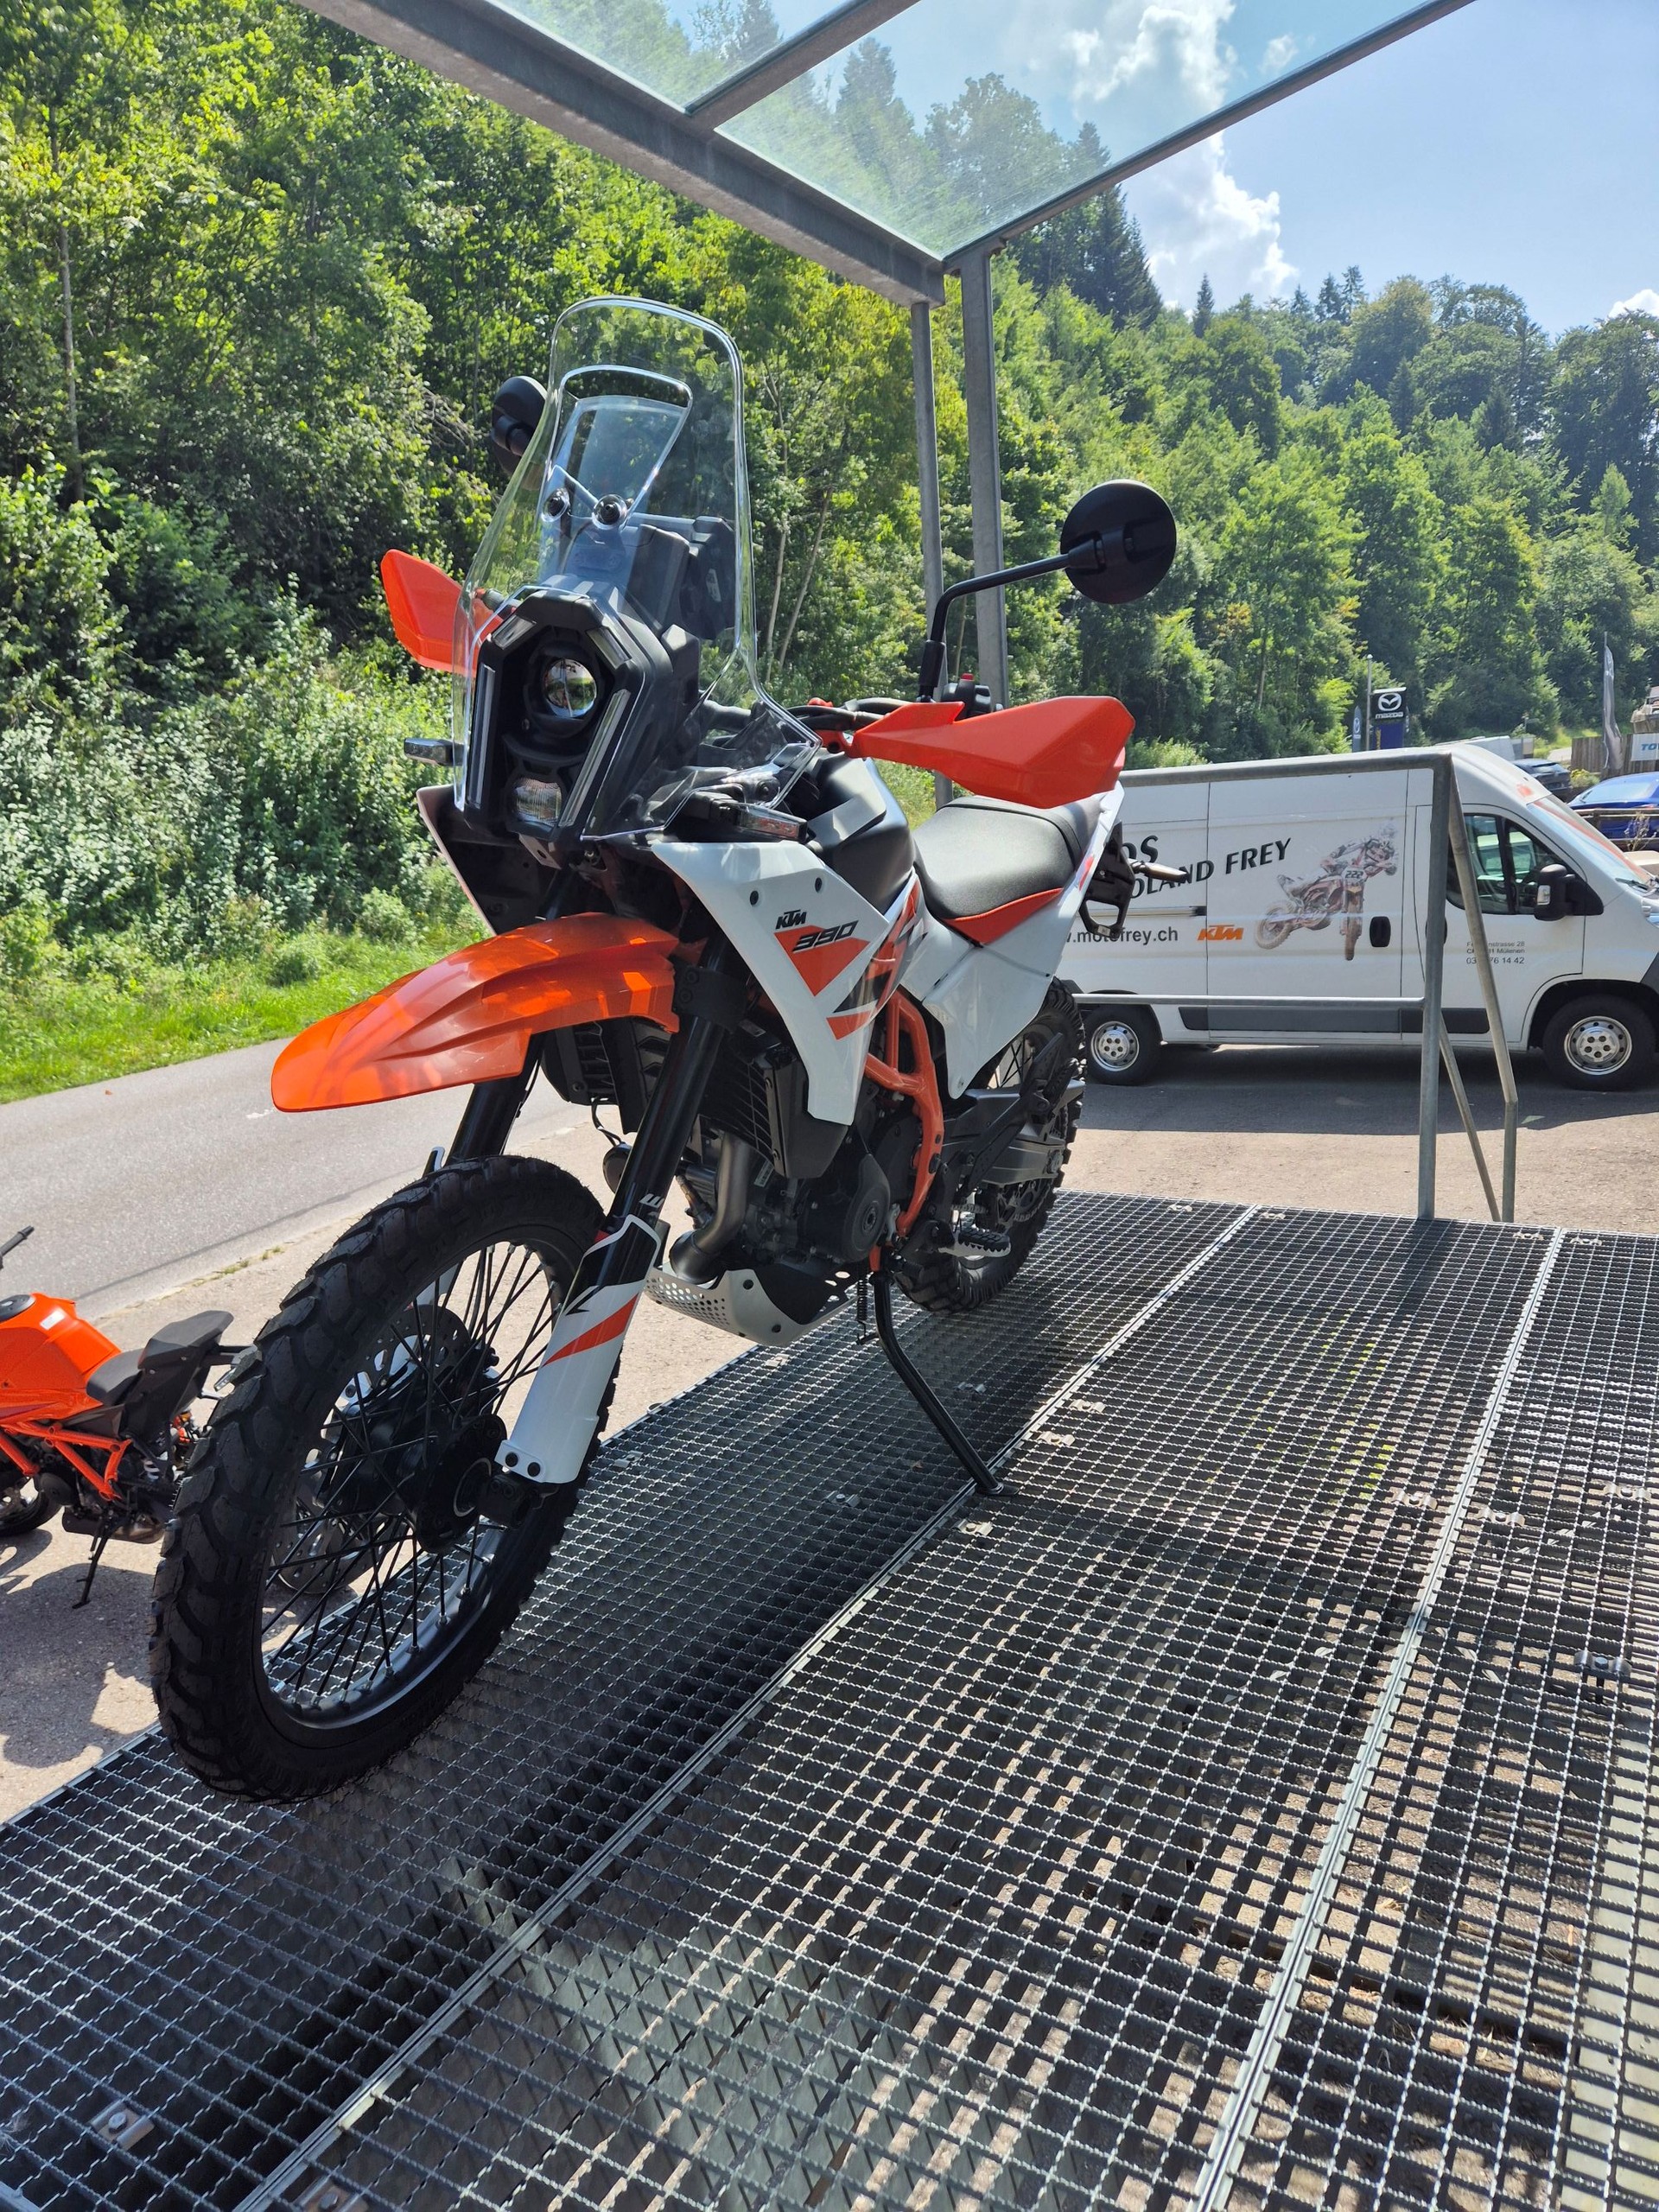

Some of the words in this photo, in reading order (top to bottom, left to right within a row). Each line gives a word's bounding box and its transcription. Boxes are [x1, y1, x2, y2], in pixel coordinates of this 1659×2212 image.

[1130, 860, 1215, 899] OLAND
[1225, 837, 1292, 875] FREY
[775, 909, 807, 930] KTM
[1197, 924, 1244, 941] KTM
[791, 919, 859, 952] 390
